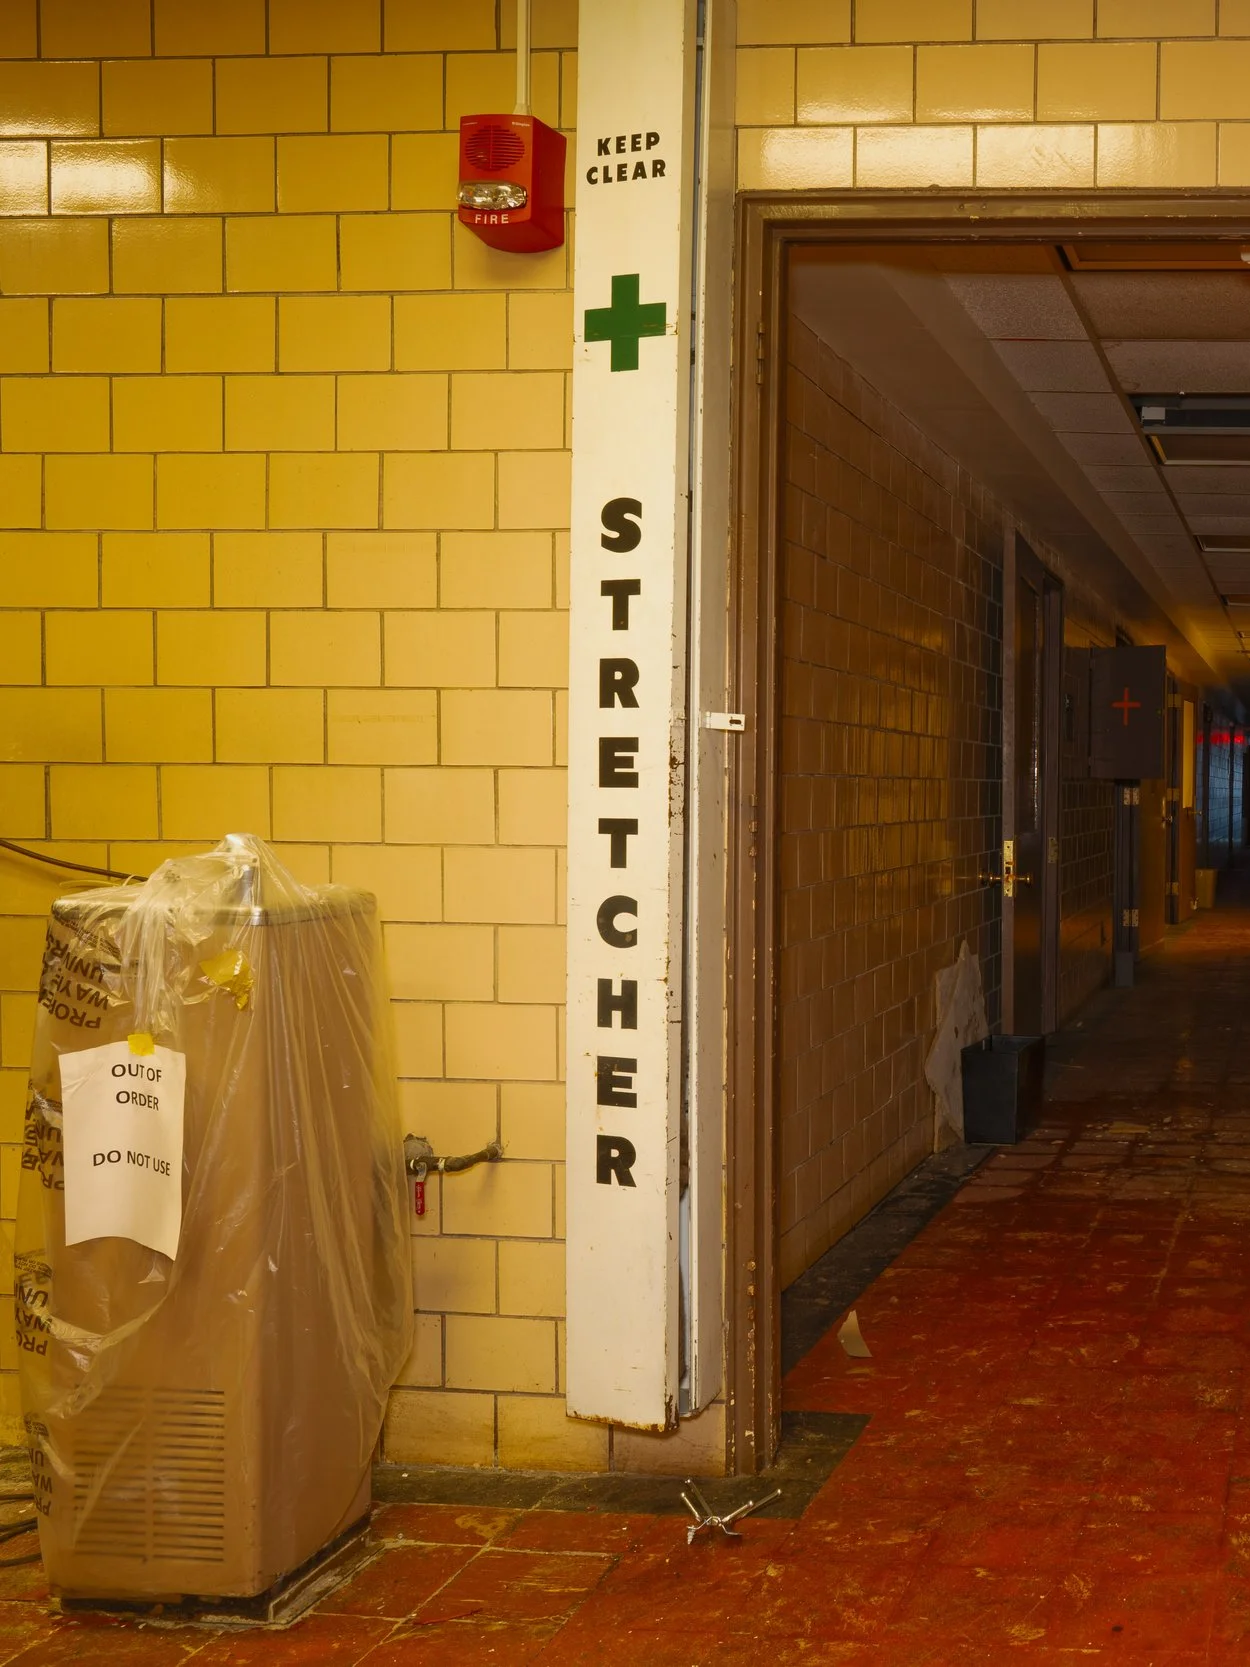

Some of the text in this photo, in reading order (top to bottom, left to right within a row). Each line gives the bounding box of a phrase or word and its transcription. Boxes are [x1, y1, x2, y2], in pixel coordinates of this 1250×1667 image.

[597, 131, 661, 157] KEEP
[586, 159, 666, 185] CLEAR
[474, 213, 509, 225] FIRE
[596, 497, 642, 1188] STRETCHER
[111, 1063, 162, 1083] OUT OF
[116, 1090, 159, 1111] ORDER
[92, 1150, 171, 1177] DO NOT USE
